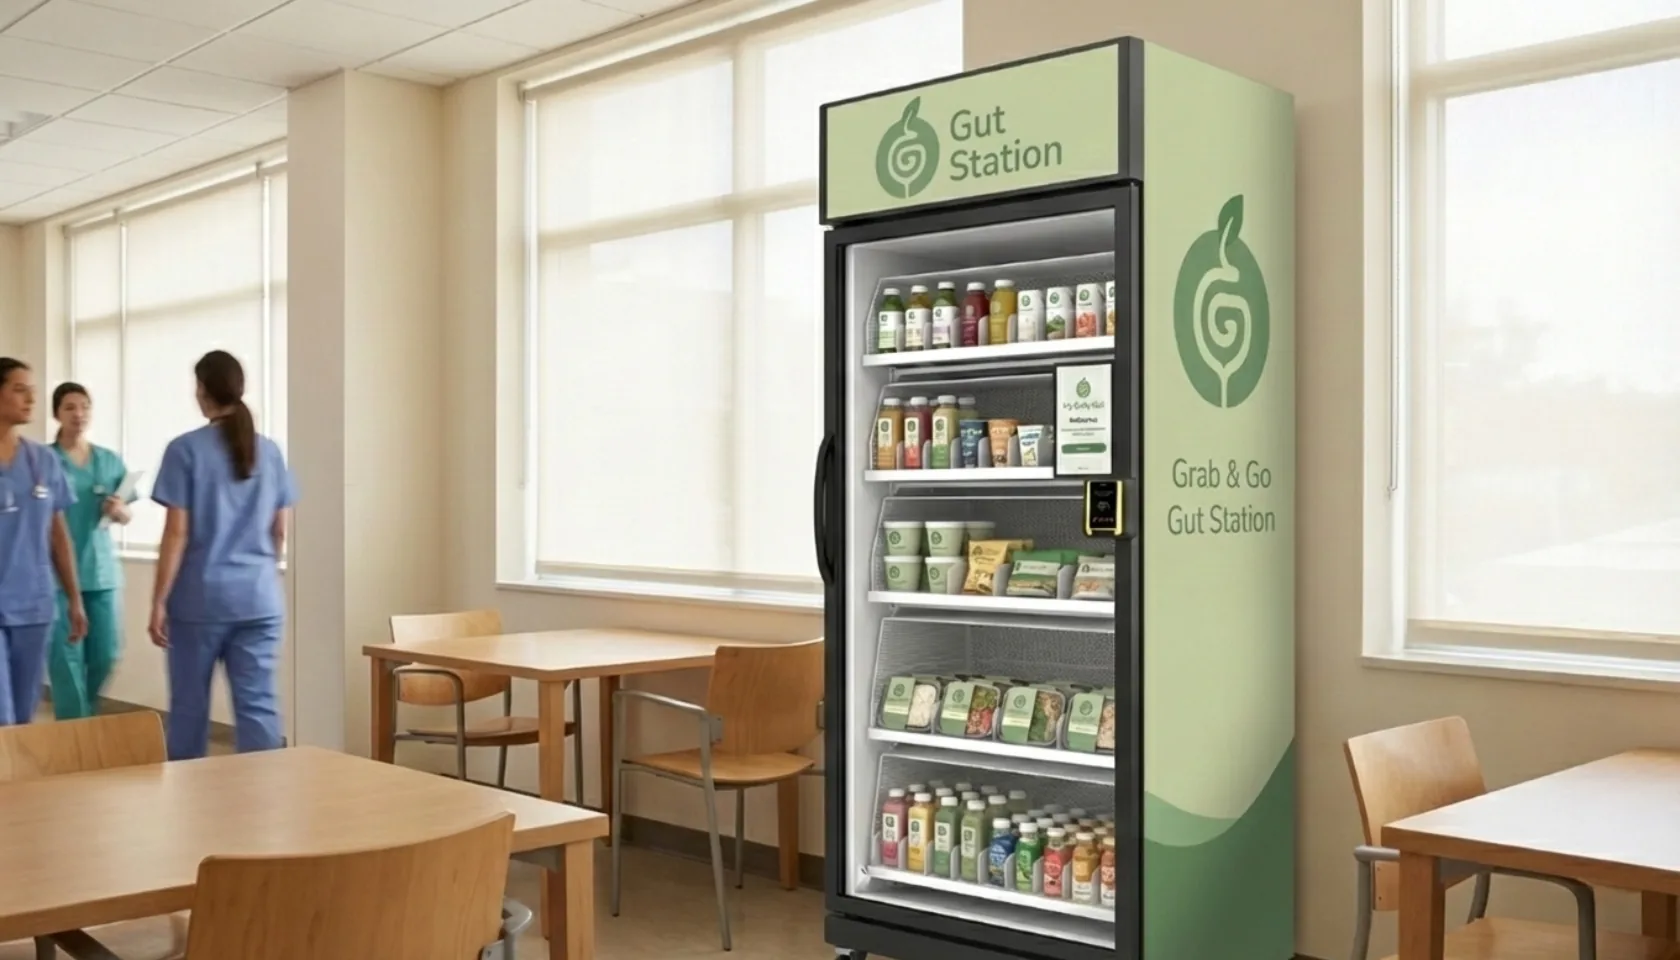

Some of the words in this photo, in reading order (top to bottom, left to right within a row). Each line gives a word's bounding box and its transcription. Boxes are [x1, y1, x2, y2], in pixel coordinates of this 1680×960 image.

[950, 105, 1007, 142] Gut
[949, 138, 1063, 182] Station
[1172, 457, 1221, 489] Grab
[1226, 459, 1241, 489] &
[1245, 459, 1272, 489] Go
[1167, 504, 1205, 536] Gut
[1209, 503, 1276, 535] Station
